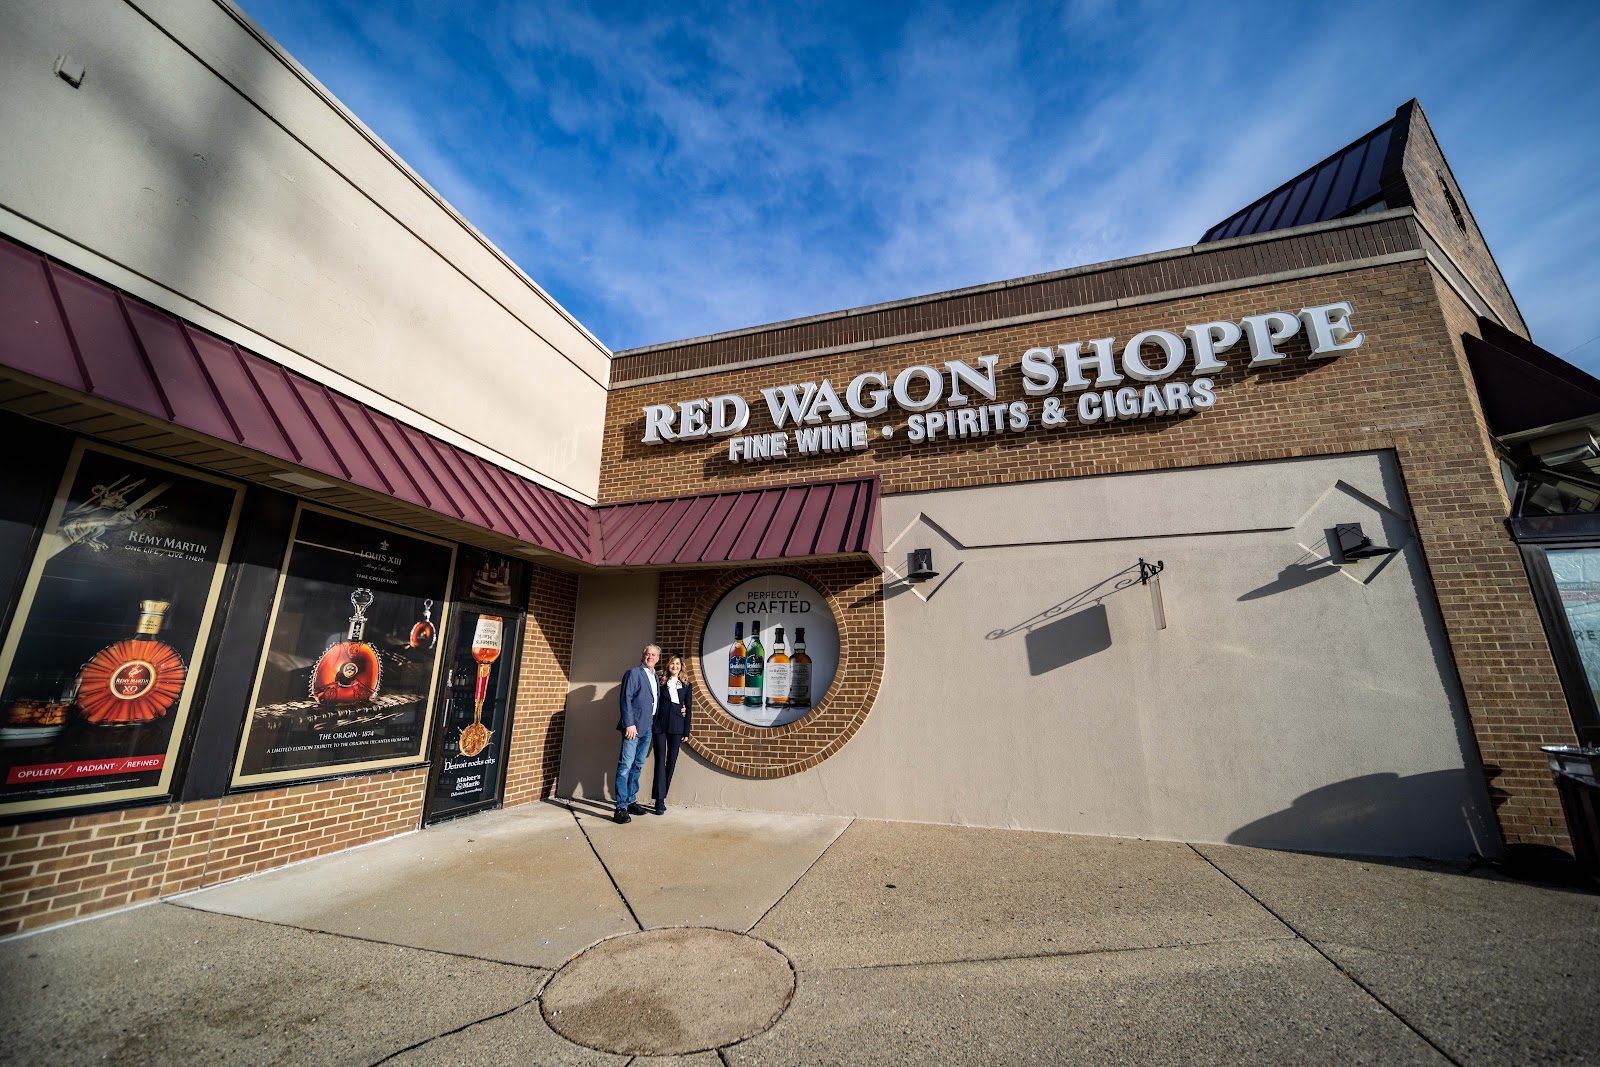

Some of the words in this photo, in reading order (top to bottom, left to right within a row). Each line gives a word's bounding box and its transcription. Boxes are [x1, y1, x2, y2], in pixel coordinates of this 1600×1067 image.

[641, 393, 750, 446] RED
[760, 353, 999, 429] WAGON
[1021, 301, 1365, 396] SHOPPE
[729, 431, 788, 464] FINE
[795, 421, 868, 457] WINE
[907, 400, 1029, 444] SPIRITS
[1041, 397, 1068, 429] &
[1078, 378, 1217, 425] CIGARS
[128, 531, 162, 546] RÉMY
[163, 537, 207, 554] MARTIN
[124, 544, 142, 552] ONE
[143, 547, 159, 555] LIFE
[168, 551, 183, 559] LIVE
[185, 554, 204, 562] THEM
[368, 575, 399, 585] COLLECTION
[747, 590, 800, 600] PERFECTLY
[735, 600, 811, 614] CRAFTED
[319, 733, 331, 741] THE
[332, 731, 358, 740] ORIGIN
[76, 763, 115, 773] RADIANT
[444, 758, 467, 773] Detroit
[468, 757, 484, 767] rocks
[456, 774, 481, 783] Maker's
[462, 780, 481, 789] Mark
